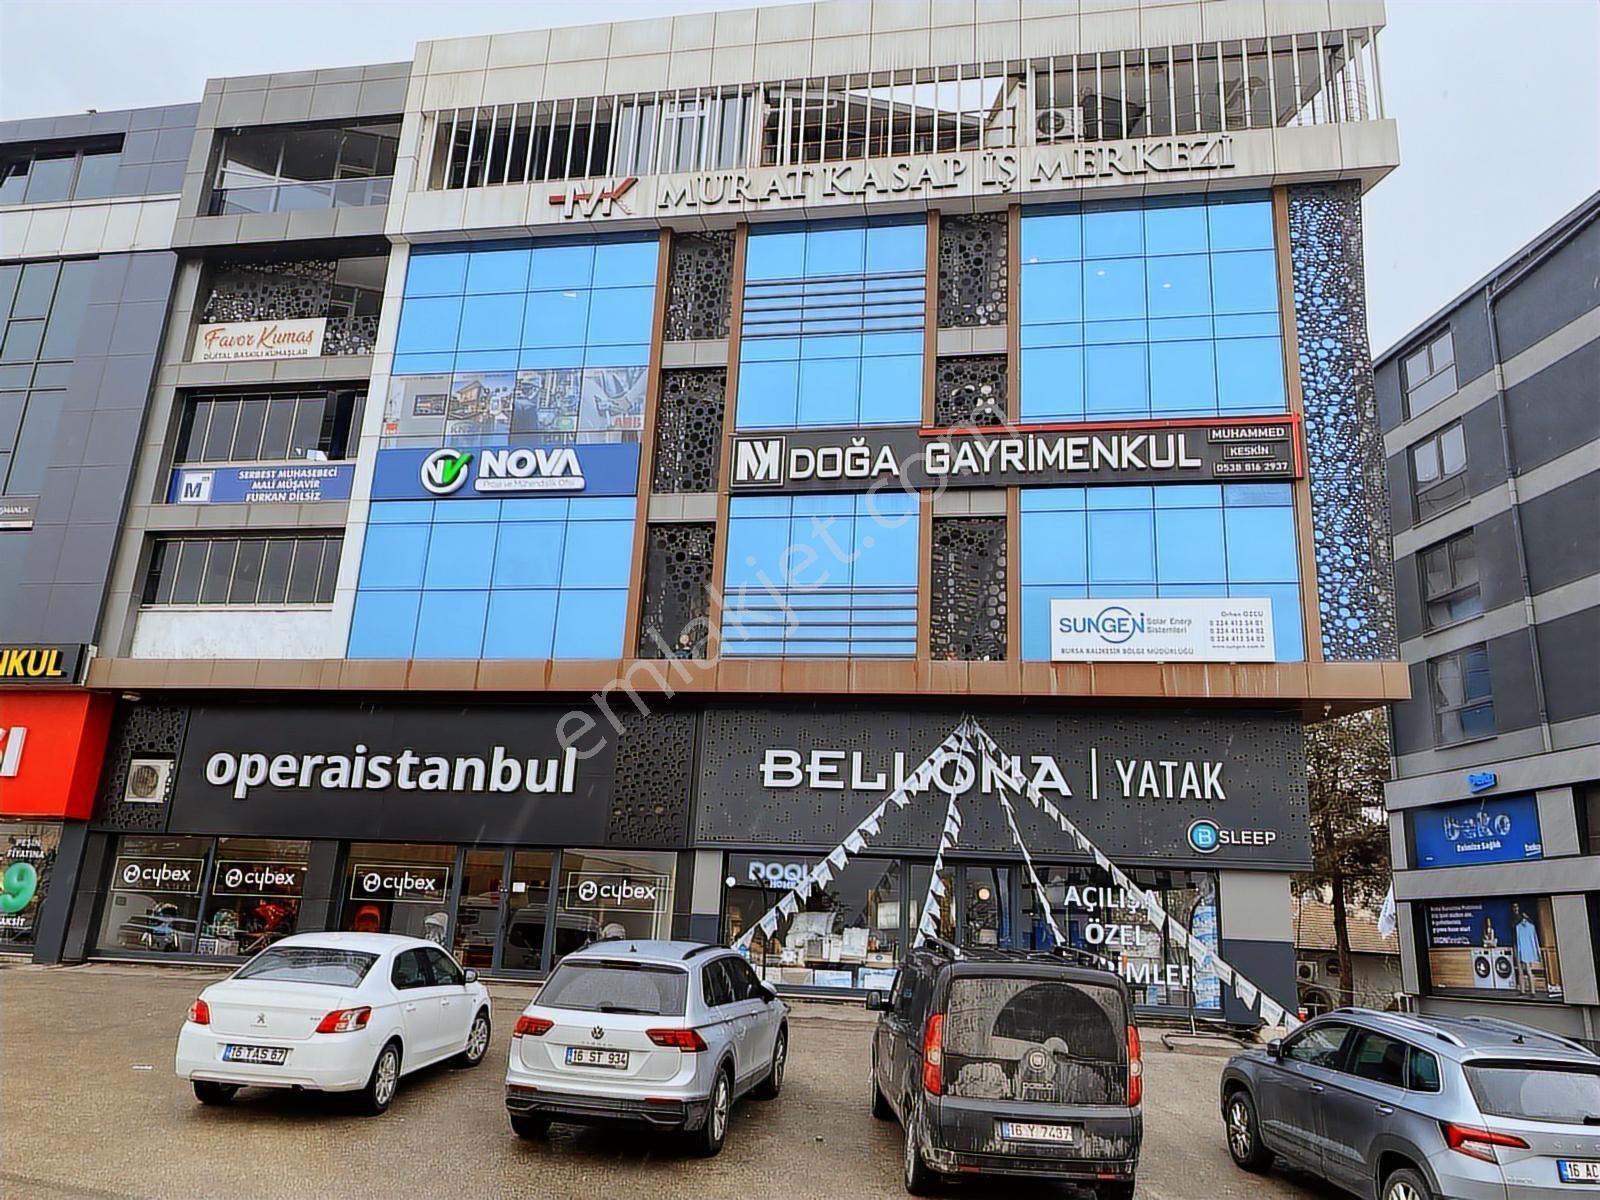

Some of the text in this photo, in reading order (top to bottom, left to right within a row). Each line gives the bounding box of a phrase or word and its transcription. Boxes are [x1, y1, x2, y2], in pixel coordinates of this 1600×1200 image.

[658, 165, 813, 208] MURAT
[823, 158, 967, 197] KASAP
[982, 147, 1017, 192] İŞ
[1030, 134, 1236, 182] MERKEZİ
[204, 327, 254, 349] Favor
[1212, 427, 1285, 439] MUHAMMED
[789, 436, 900, 480] DOĞA
[925, 433, 1202, 475] GAYRİMENKUL
[1230, 445, 1269, 456] KESKİN
[238, 466, 338, 480] SERBEST MUHASEBECİ
[479, 448, 584, 477] NOVA
[246, 492, 288, 503] FURKAN
[205, 743, 577, 799] operaistanbul
[1114, 759, 1227, 800] YATAK
[1219, 829, 1276, 845] SLEEP
[142, 863, 192, 887] cybex
[244, 867, 296, 891] cybex
[384, 871, 436, 896] cybex
[600, 880, 657, 905] cybex
[1085, 917, 1148, 947] ÖZEL
[231, 1047, 284, 1060] 16 TAS 67
[573, 1050, 626, 1065] 16 ST 934
[1010, 1124, 1022, 1136] 16
[1028, 1124, 1035, 1137] Y
[1568, 1163, 1580, 1177] 16
